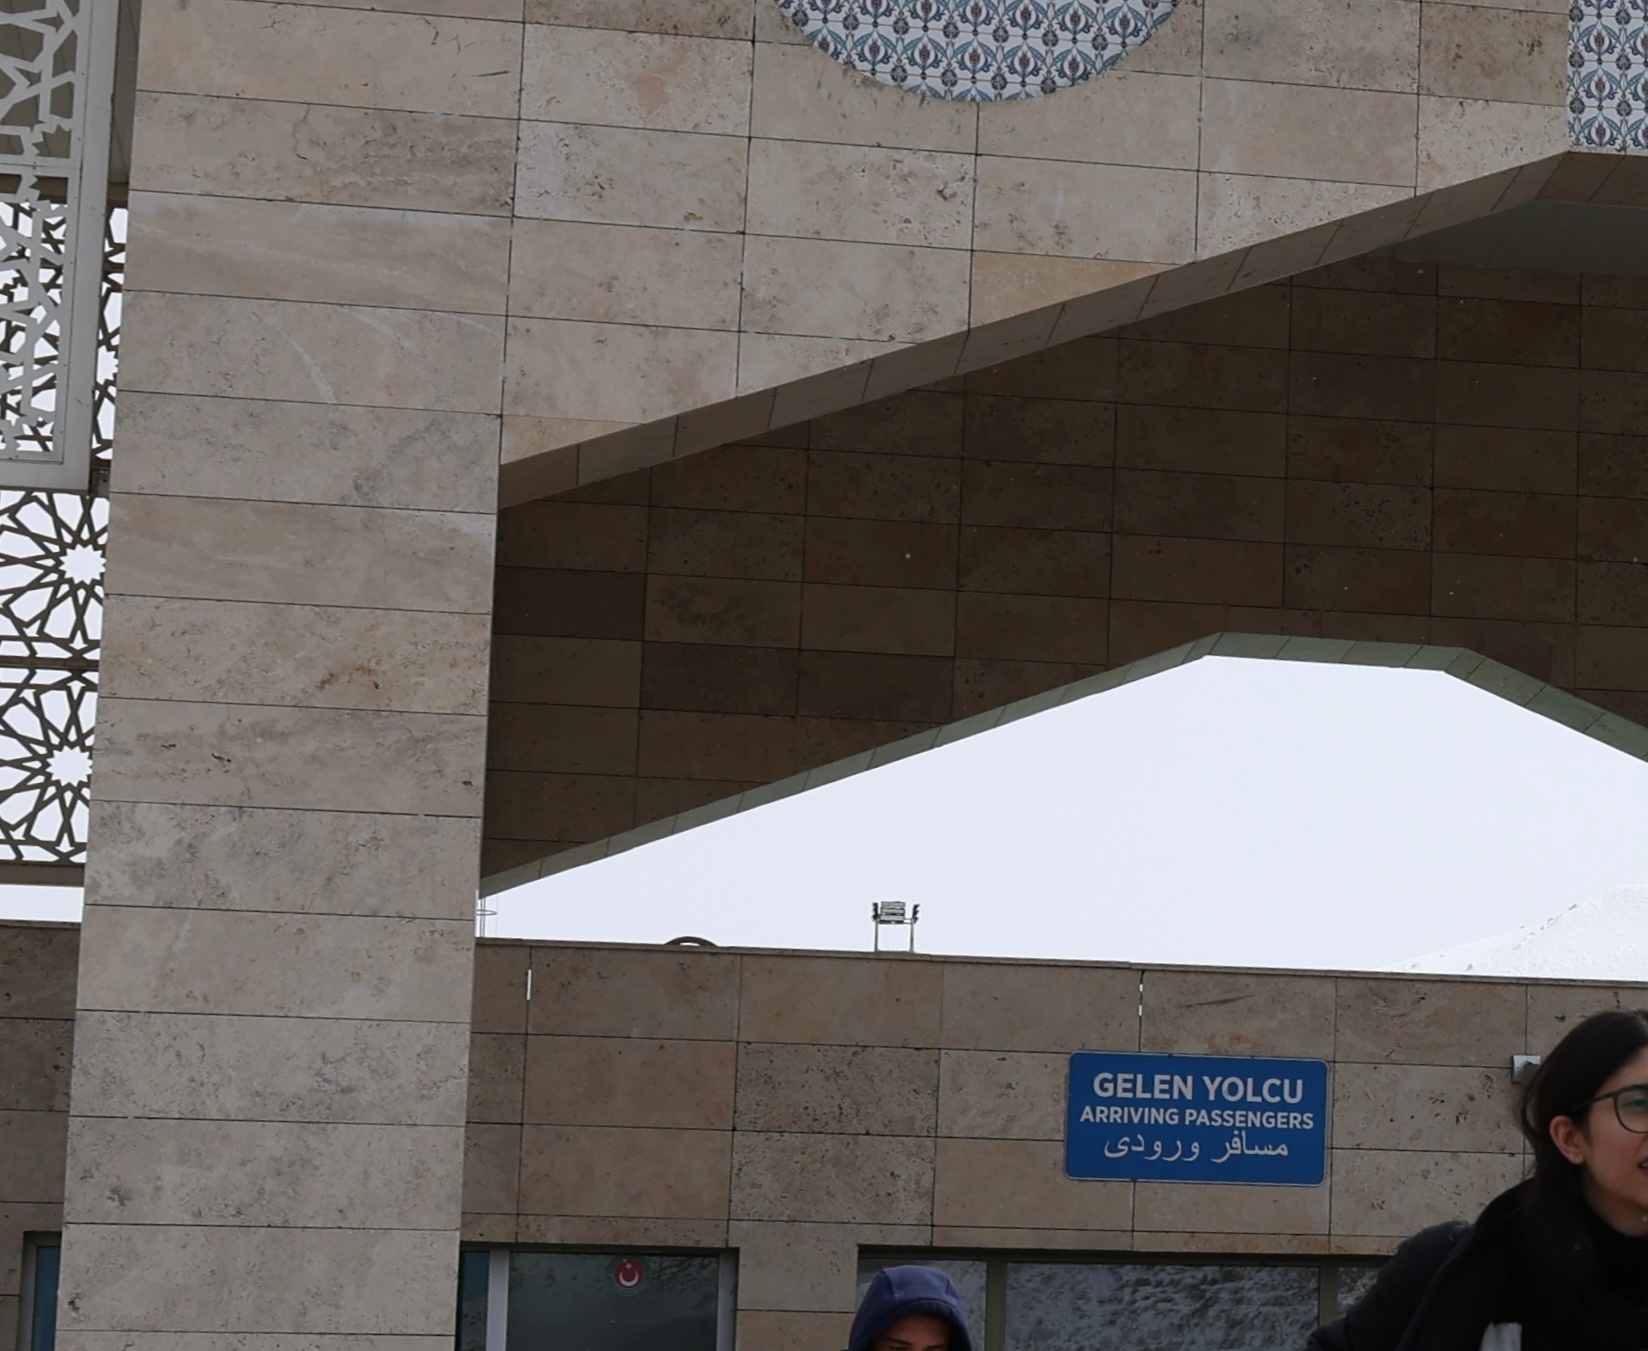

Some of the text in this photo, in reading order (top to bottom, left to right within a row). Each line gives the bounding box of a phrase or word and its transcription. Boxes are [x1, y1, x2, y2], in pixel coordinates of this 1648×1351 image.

[1093, 1072, 1303, 1103] GELEN YOLCU
[1079, 1105, 1314, 1129] ARRIVING PASSENGERS
[1211, 1129, 1289, 1163] مسافر
